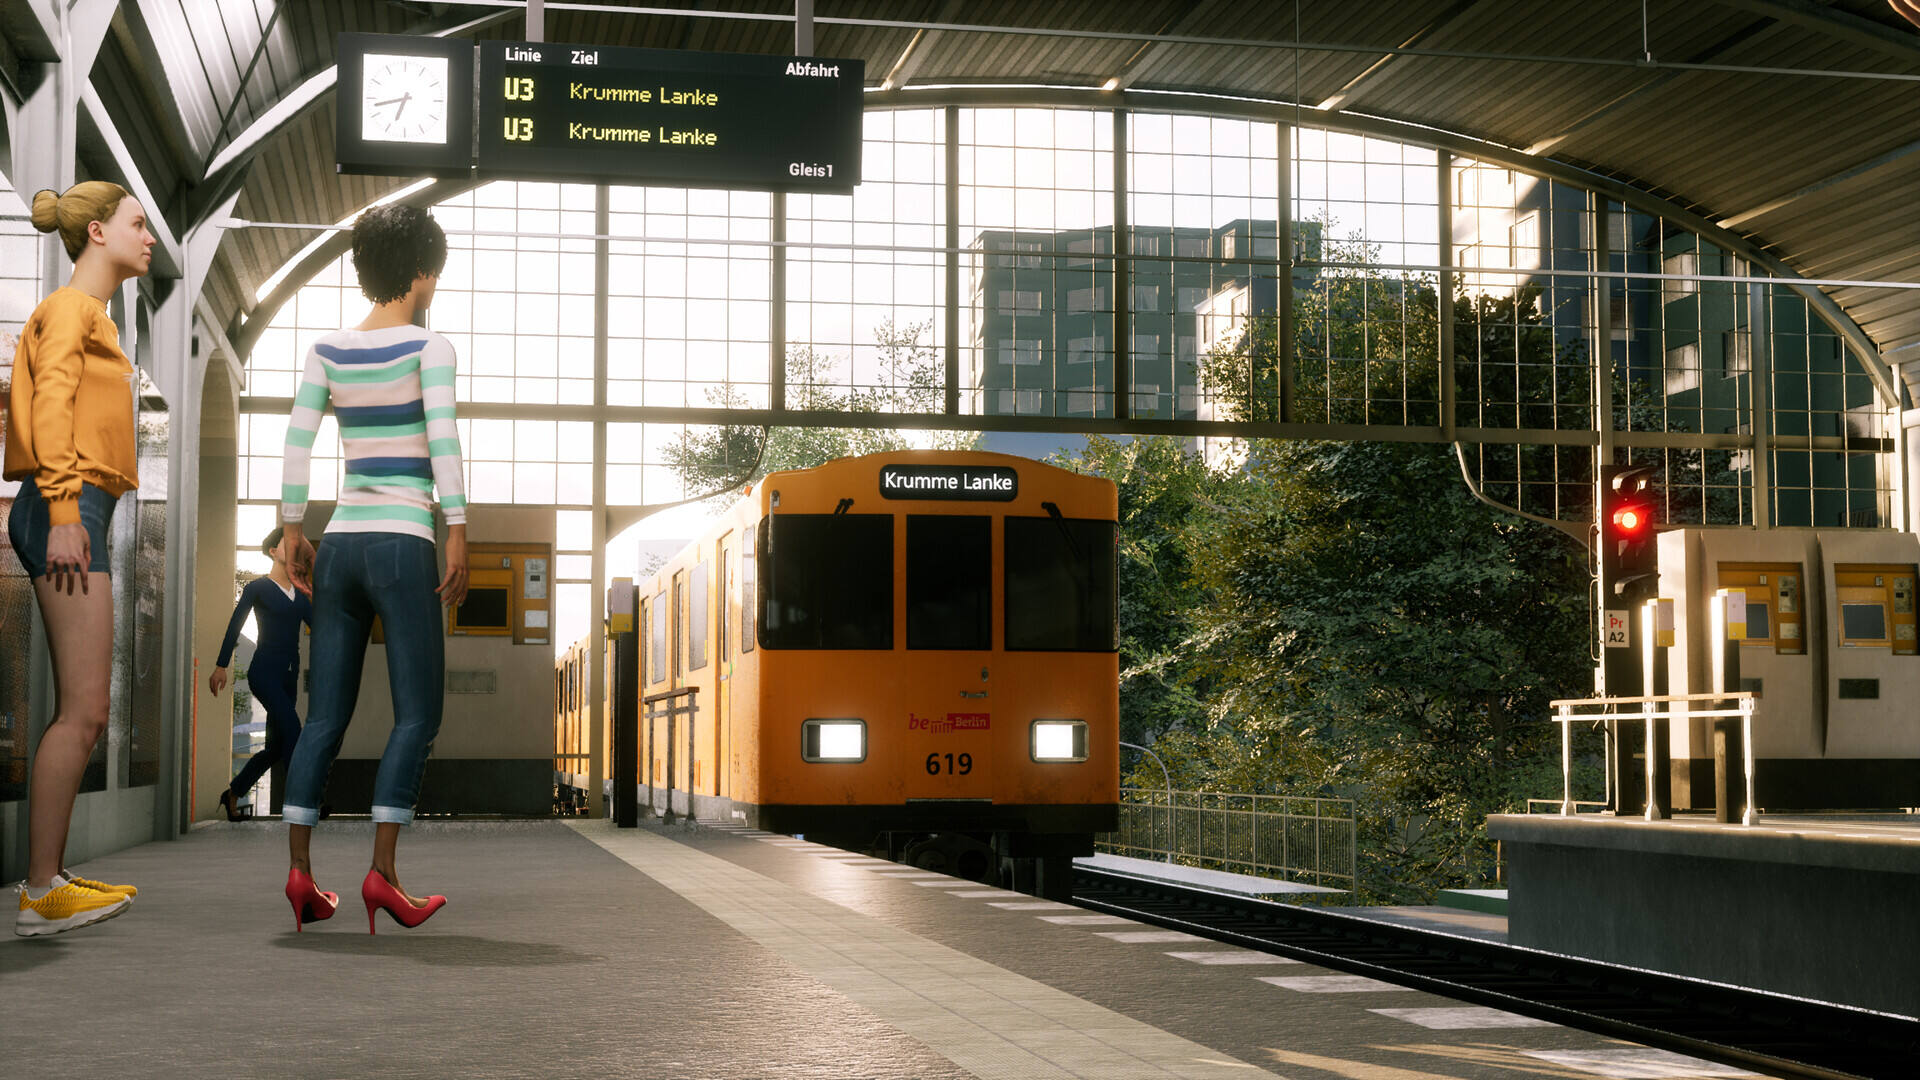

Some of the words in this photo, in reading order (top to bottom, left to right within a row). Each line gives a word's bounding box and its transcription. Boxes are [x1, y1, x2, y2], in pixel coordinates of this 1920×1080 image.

[505, 47, 542, 63] Linie
[571, 50, 599, 65] Ziel
[785, 61, 840, 78] Abfahrt
[504, 77, 535, 101] U3
[570, 82, 652, 103] Krumme
[660, 87, 719, 106] Lanke
[503, 117, 534, 141] U3
[569, 122, 651, 143] Krumme
[659, 127, 718, 146] Lanke
[885, 471, 958, 489] Krumme
[963, 473, 1013, 490] Lanke
[1610, 617, 1624, 629] Pr
[1609, 632, 1625, 643] A2
[955, 715, 987, 727] Berlin
[926, 752, 973, 776] 619
